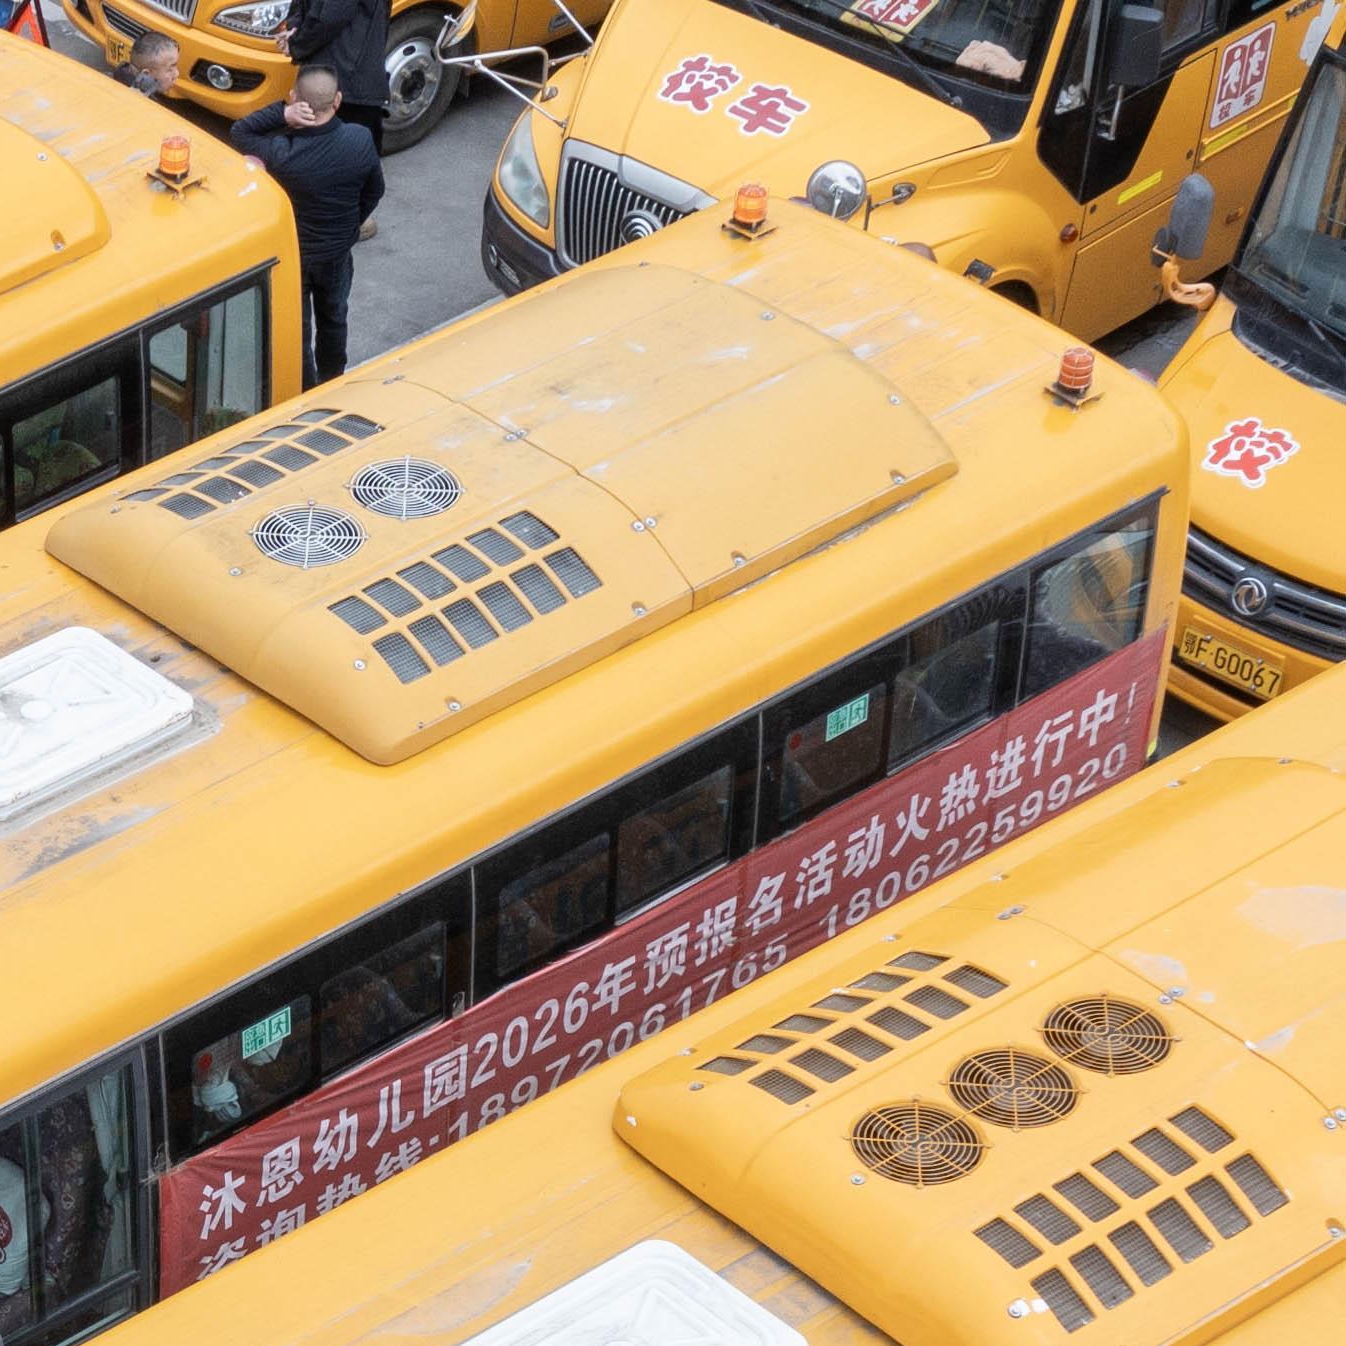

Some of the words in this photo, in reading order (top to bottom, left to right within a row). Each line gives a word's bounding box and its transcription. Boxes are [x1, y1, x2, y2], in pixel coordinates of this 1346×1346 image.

[658, 55, 809, 136] 校车
[1203, 418, 1299, 487] 校
[818, 743, 1128, 939] 18062259920
